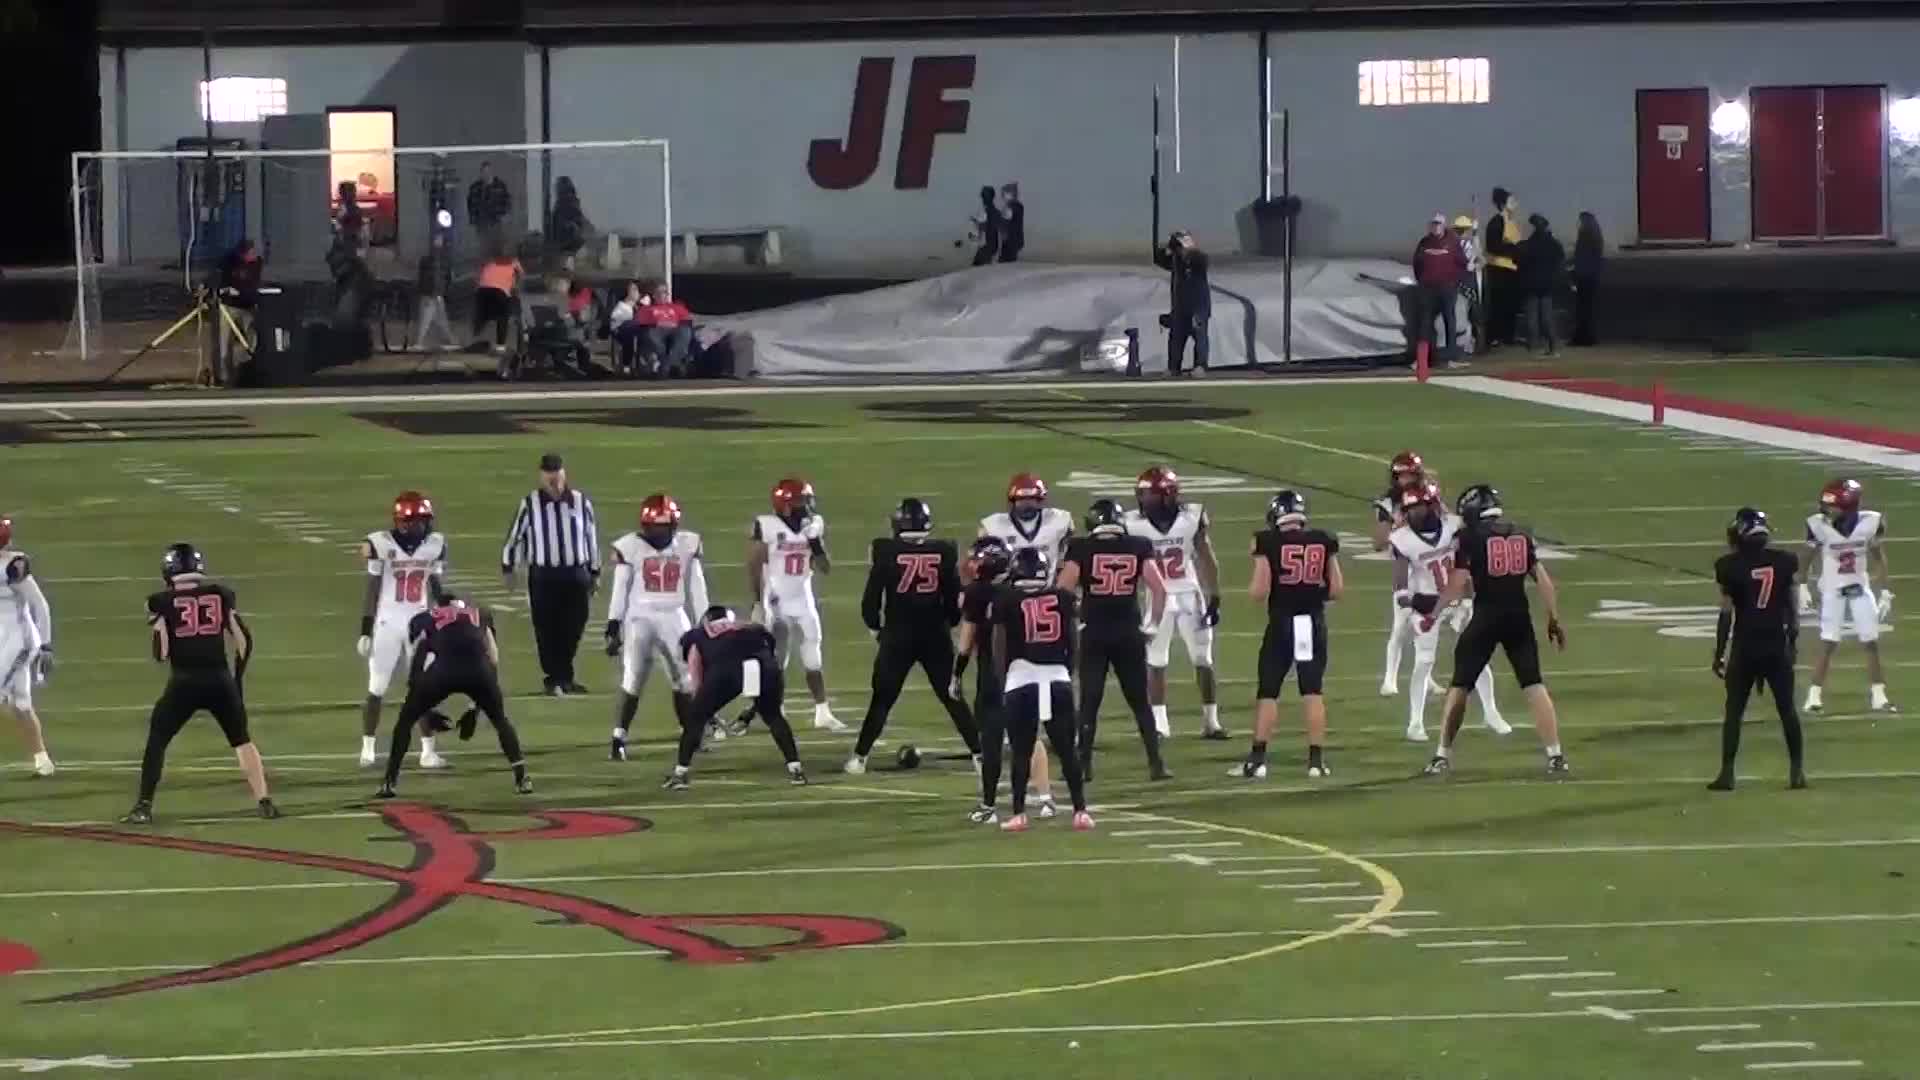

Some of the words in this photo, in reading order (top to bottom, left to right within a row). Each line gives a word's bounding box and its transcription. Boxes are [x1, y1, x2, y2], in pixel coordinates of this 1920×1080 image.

[807, 55, 976, 190] JF
[896, 554, 942, 593] 75
[1090, 554, 1138, 595] 52
[1279, 544, 1326, 585] 58
[1487, 535, 1529, 577] 88
[1751, 566, 1774, 609] 7
[173, 594, 224, 637] 33
[1021, 594, 1061, 644] 15
